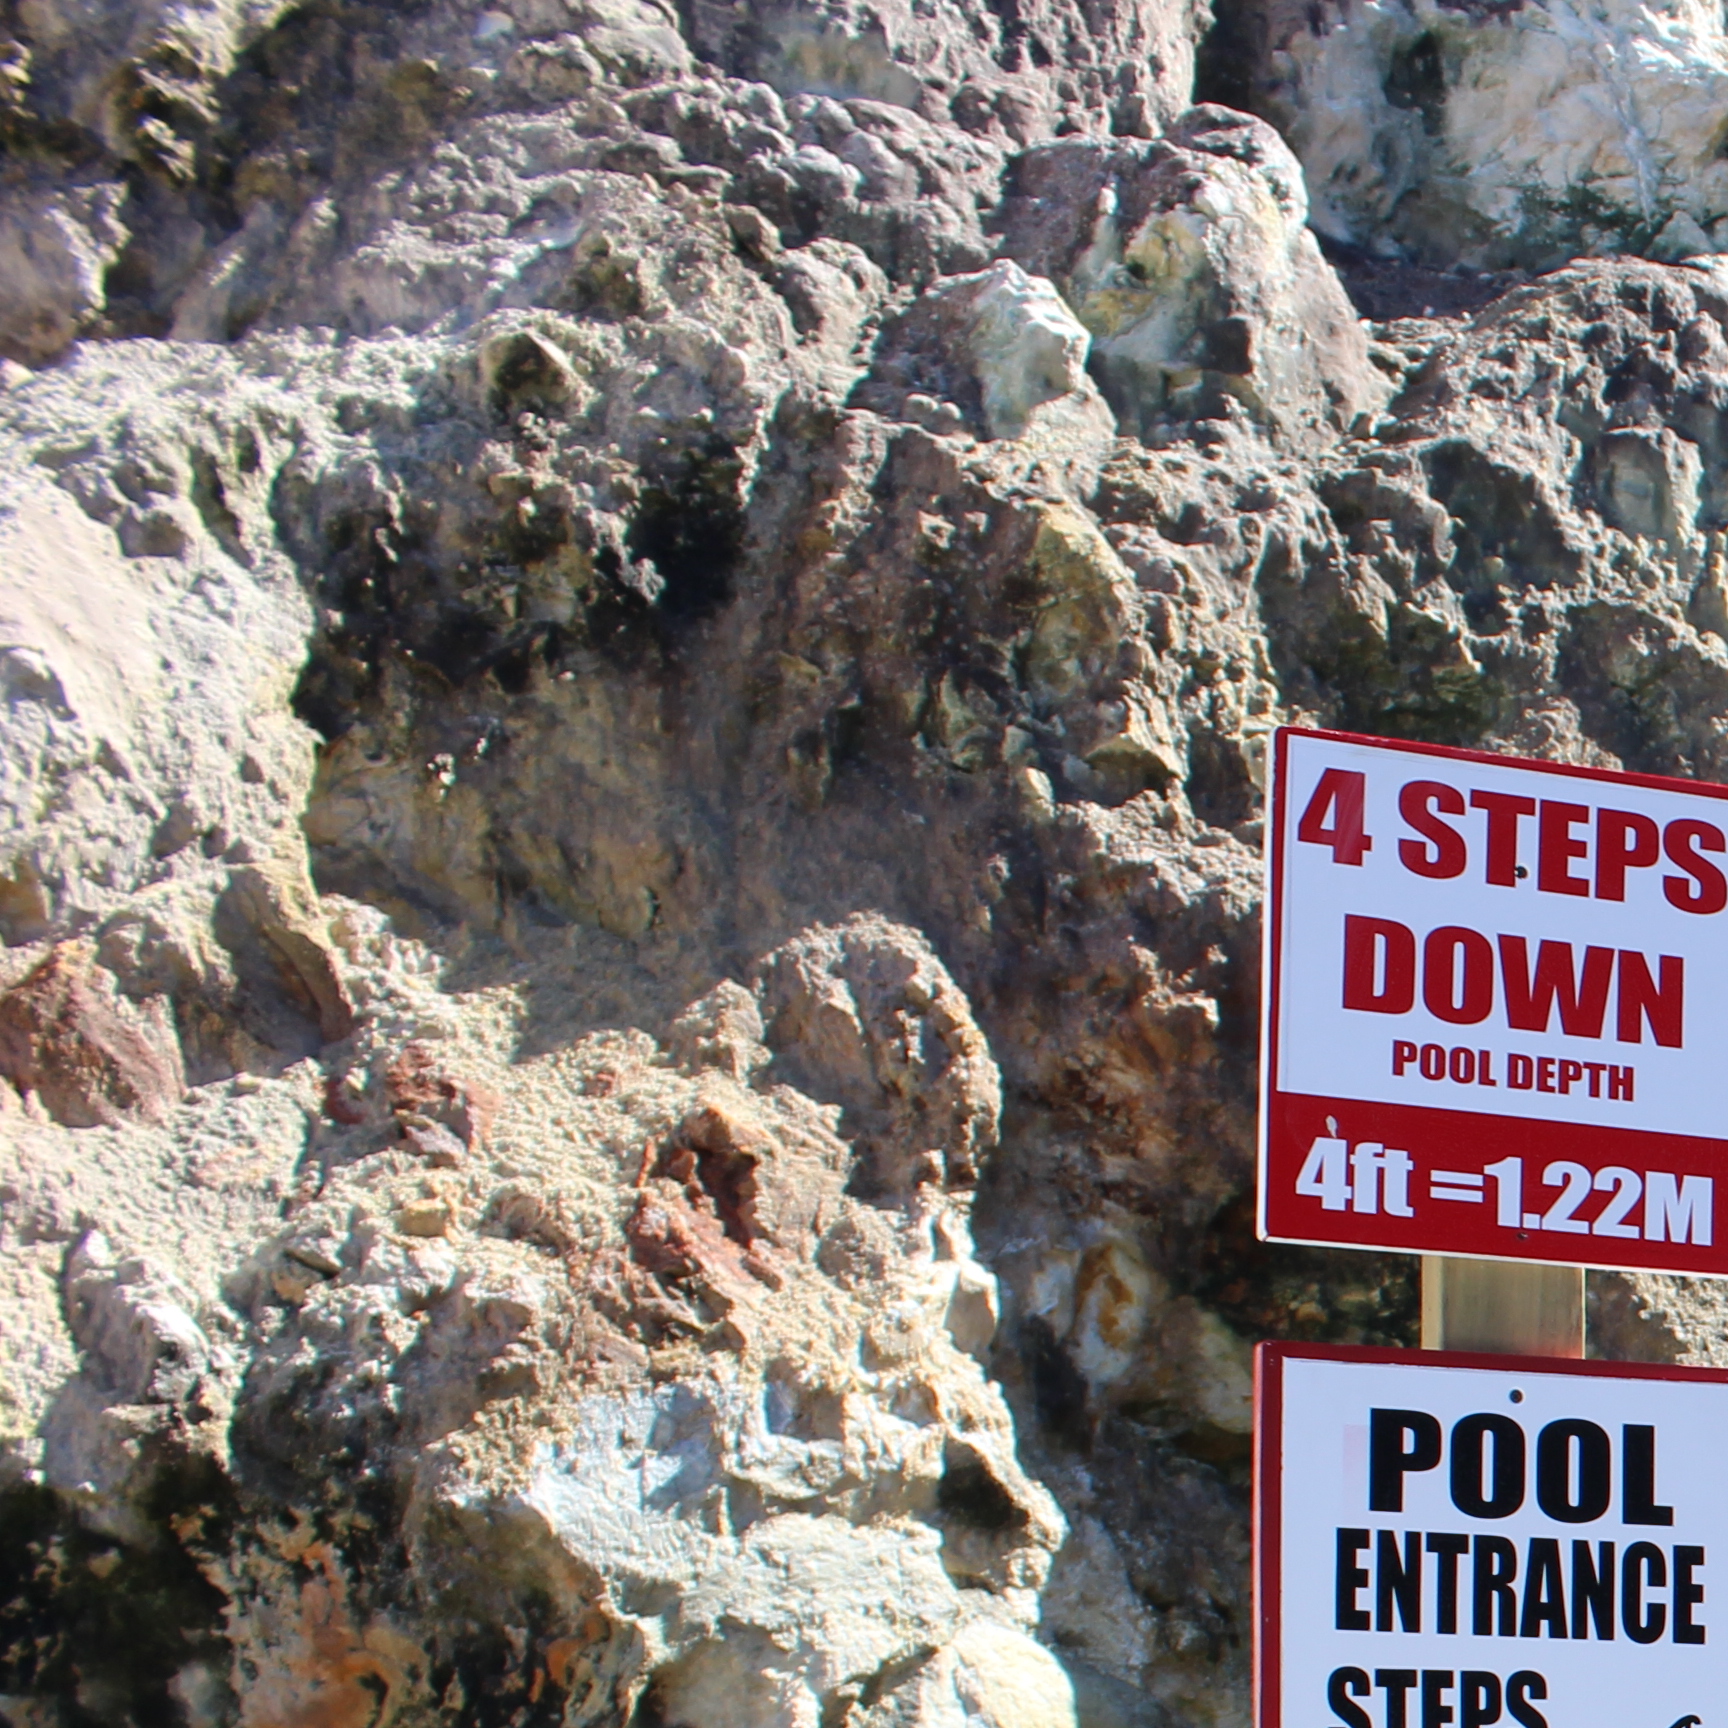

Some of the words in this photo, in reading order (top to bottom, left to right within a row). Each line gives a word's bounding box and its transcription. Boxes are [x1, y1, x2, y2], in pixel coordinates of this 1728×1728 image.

[1297, 766, 1372, 867] 4
[1397, 780, 1728, 916] STEPS
[1342, 914, 1684, 1049] DOWN
[1392, 1038, 1498, 1089] POOL
[1506, 1054, 1633, 1103] DEPTH
[1294, 1134, 1414, 1219] 4ft
[1367, 1406, 1674, 1527] POOL
[1333, 1526, 1706, 1646] ENTRANCE
